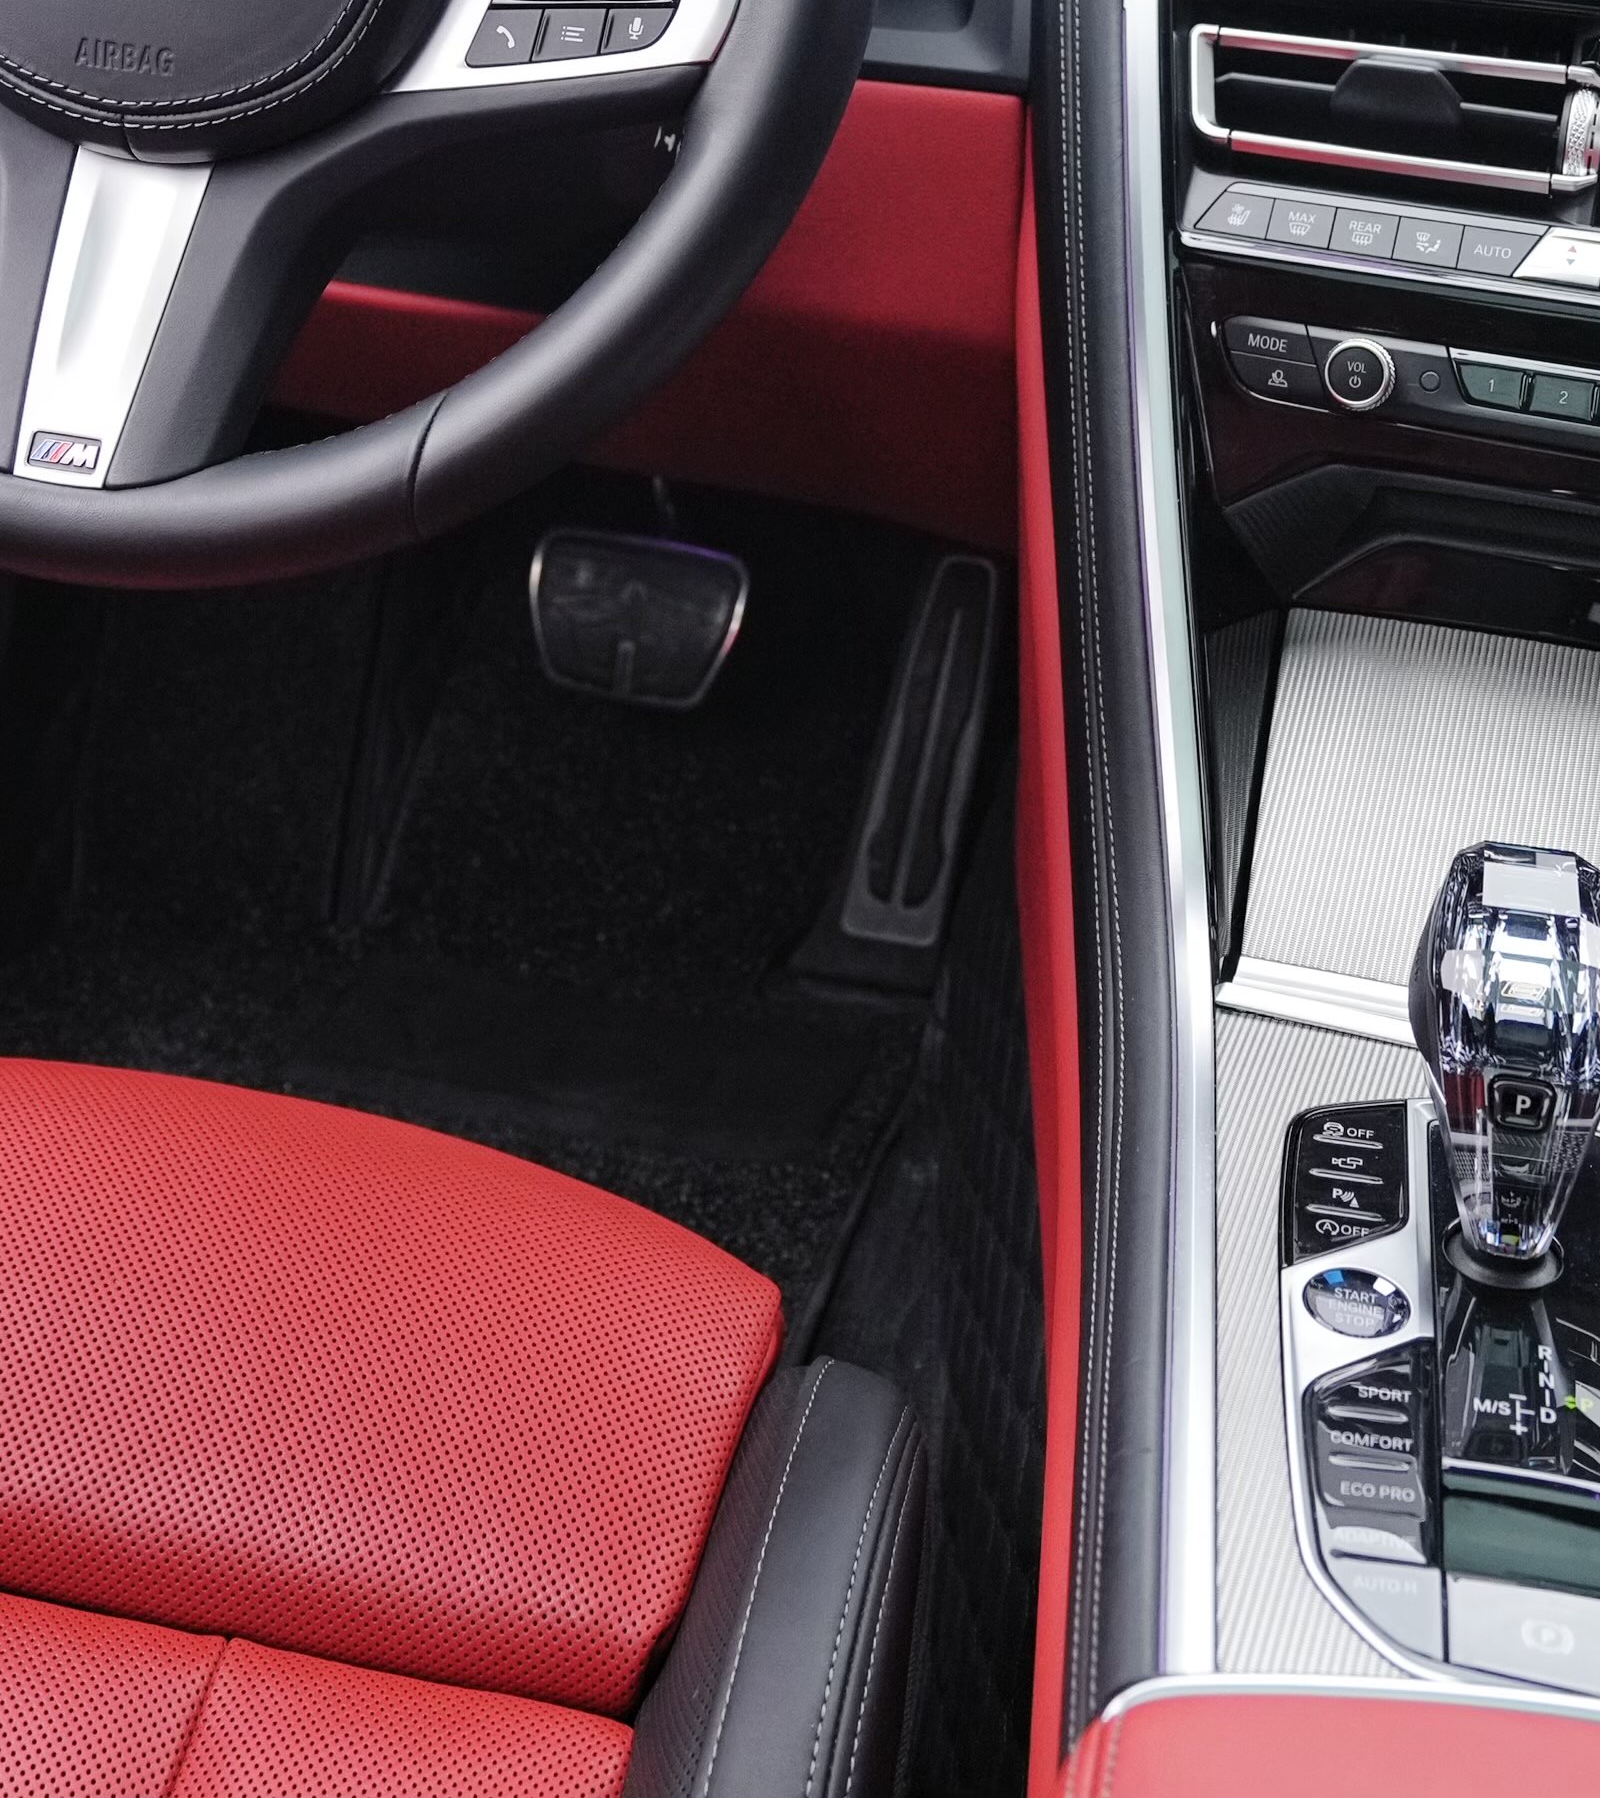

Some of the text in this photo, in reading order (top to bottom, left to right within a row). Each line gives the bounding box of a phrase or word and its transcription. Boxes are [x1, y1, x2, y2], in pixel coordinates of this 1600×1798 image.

[75, 36, 176, 77] AIRBAG
[1288, 210, 1317, 224] MAX
[1349, 220, 1382, 235] REAR
[1473, 244, 1512, 259] AUTO
[1247, 333, 1288, 353] MODE
[1347, 360, 1367, 374] VOL
[1488, 378, 1495, 393] 1
[1559, 390, 1568, 405] 2
[1515, 1095, 1531, 1116] P
[1347, 1127, 1375, 1139] OFF
[1341, 1225, 1370, 1238] OFF
[1334, 1287, 1378, 1304] START
[1328, 1298, 1385, 1319] ENGINE
[1335, 1312, 1374, 1328] STOP
[1357, 1386, 1412, 1403] SPORT
[1473, 1397, 1512, 1416] M/S
[1330, 1430, 1414, 1452] COMFORT
[1340, 1481, 1415, 1503] ECO PRO
